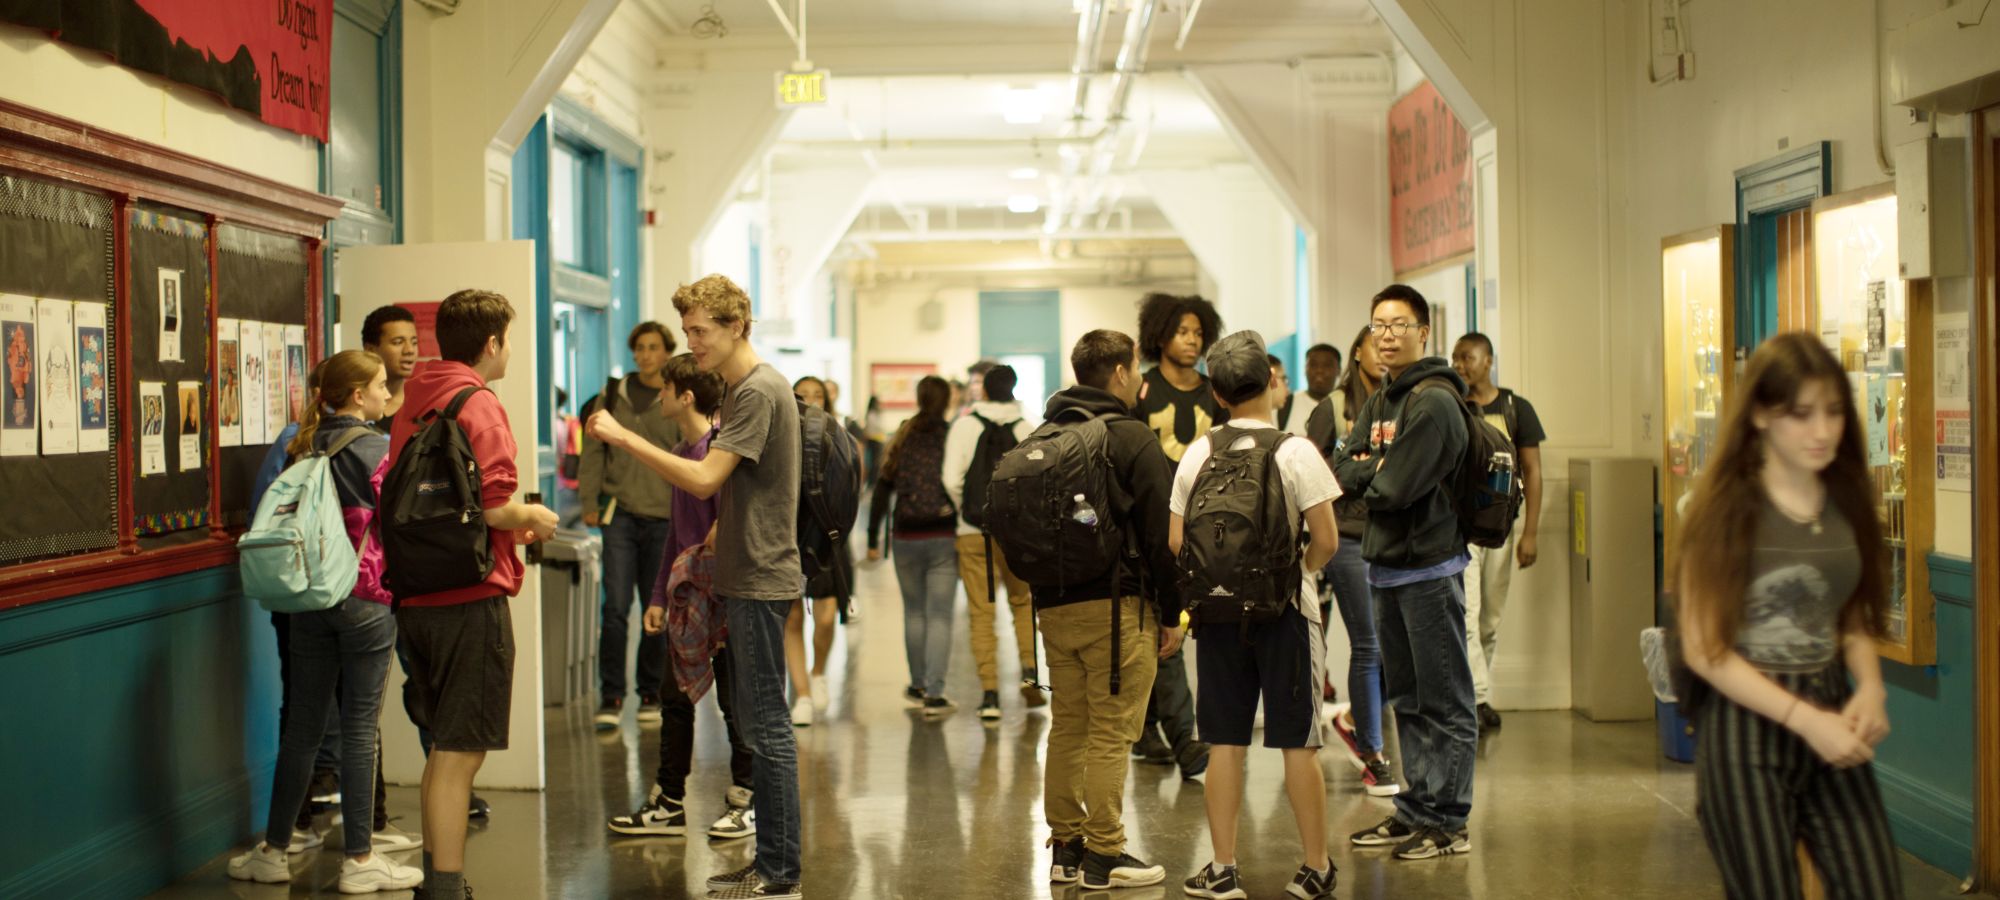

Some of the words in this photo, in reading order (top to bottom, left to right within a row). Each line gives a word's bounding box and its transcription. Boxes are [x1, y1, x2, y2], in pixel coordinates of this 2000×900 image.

[294, 0, 319, 50] right
[271, 51, 305, 110] Dream
[784, 74, 826, 103] EXIT
